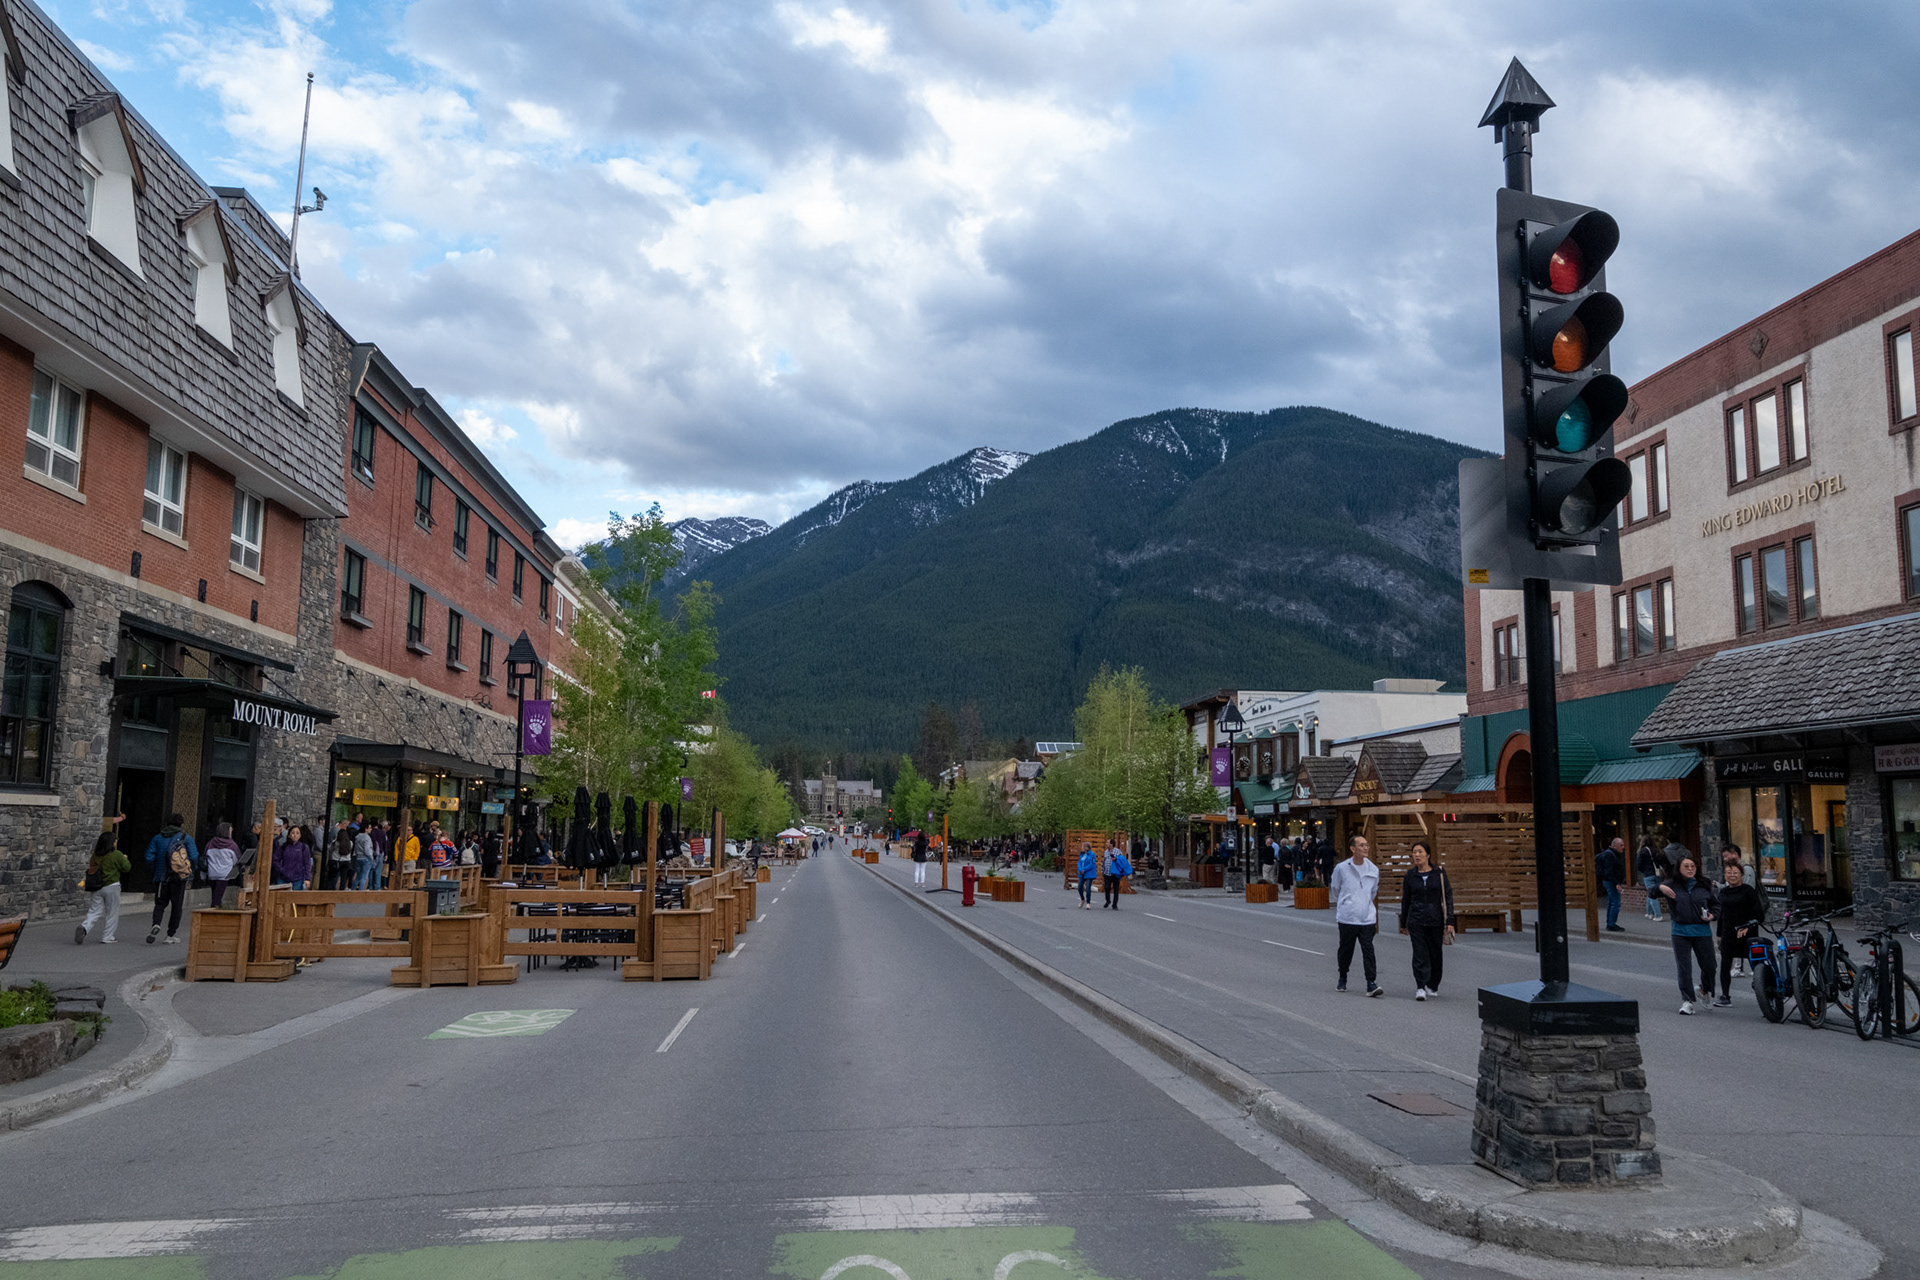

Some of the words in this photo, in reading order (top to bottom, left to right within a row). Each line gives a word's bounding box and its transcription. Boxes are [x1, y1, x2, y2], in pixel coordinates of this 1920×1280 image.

[1702, 514, 1731, 538] KING
[1735, 493, 1793, 527] EDWARD
[1796, 474, 1846, 506] HOTEL
[232, 699, 281, 729] MOUNT
[282, 710, 317, 736] ROYAL
[1808, 771, 1845, 779] GALLERY
